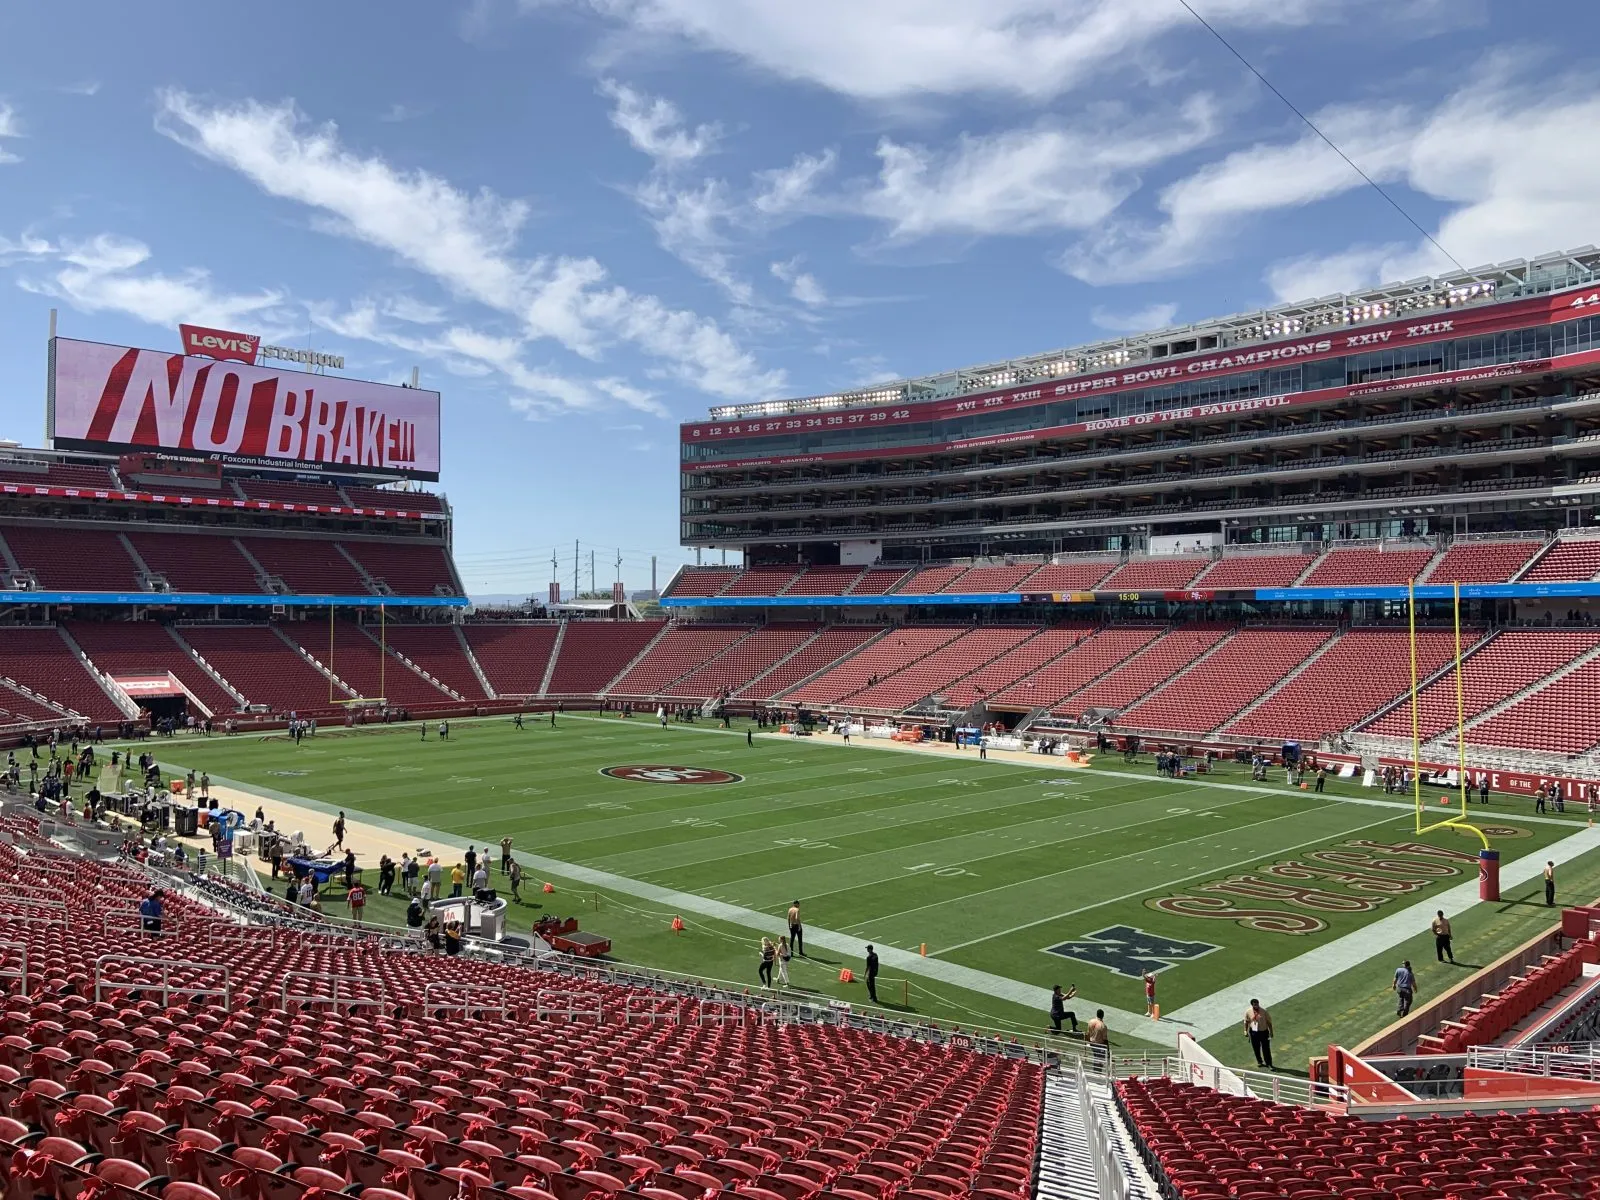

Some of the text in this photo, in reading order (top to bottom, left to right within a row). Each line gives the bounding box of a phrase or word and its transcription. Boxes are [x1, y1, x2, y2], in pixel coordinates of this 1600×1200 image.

[263, 344, 345, 370] STADIUM
[956, 320, 1454, 411] XVI XIX XXIII SUPER BOWL CHAMPIONS XXIV XXIX
[1349, 368, 1522, 396] 6-TIME CONFERENCE CHAMPIONS
[108, 349, 258, 453] NO
[1085, 396, 1290, 431] HOME OF THE FAITHFUL
[692, 429, 700, 437] 8
[728, 426, 740, 434] 14
[747, 424, 760, 432] 16
[766, 422, 781, 430] 27
[806, 419, 822, 427] 34
[827, 416, 843, 425] 35
[848, 414, 865, 423] 37
[870, 412, 887, 421] 39
[891, 410, 910, 419] 42
[222, 454, 257, 464] Foxconn
[258, 458, 294, 468] Industrial
[294, 460, 323, 470] Internet
[1118, 592, 1139, 601] 15:00
[1519, 780, 1532, 788] THE
[773, 838, 830, 849] 20
[902, 863, 966, 876] 10
[352, 891, 363, 901] 80
[586, 970, 599, 979] 109
[951, 1036, 969, 1047] 108
[1551, 1045, 1569, 1054] 106
